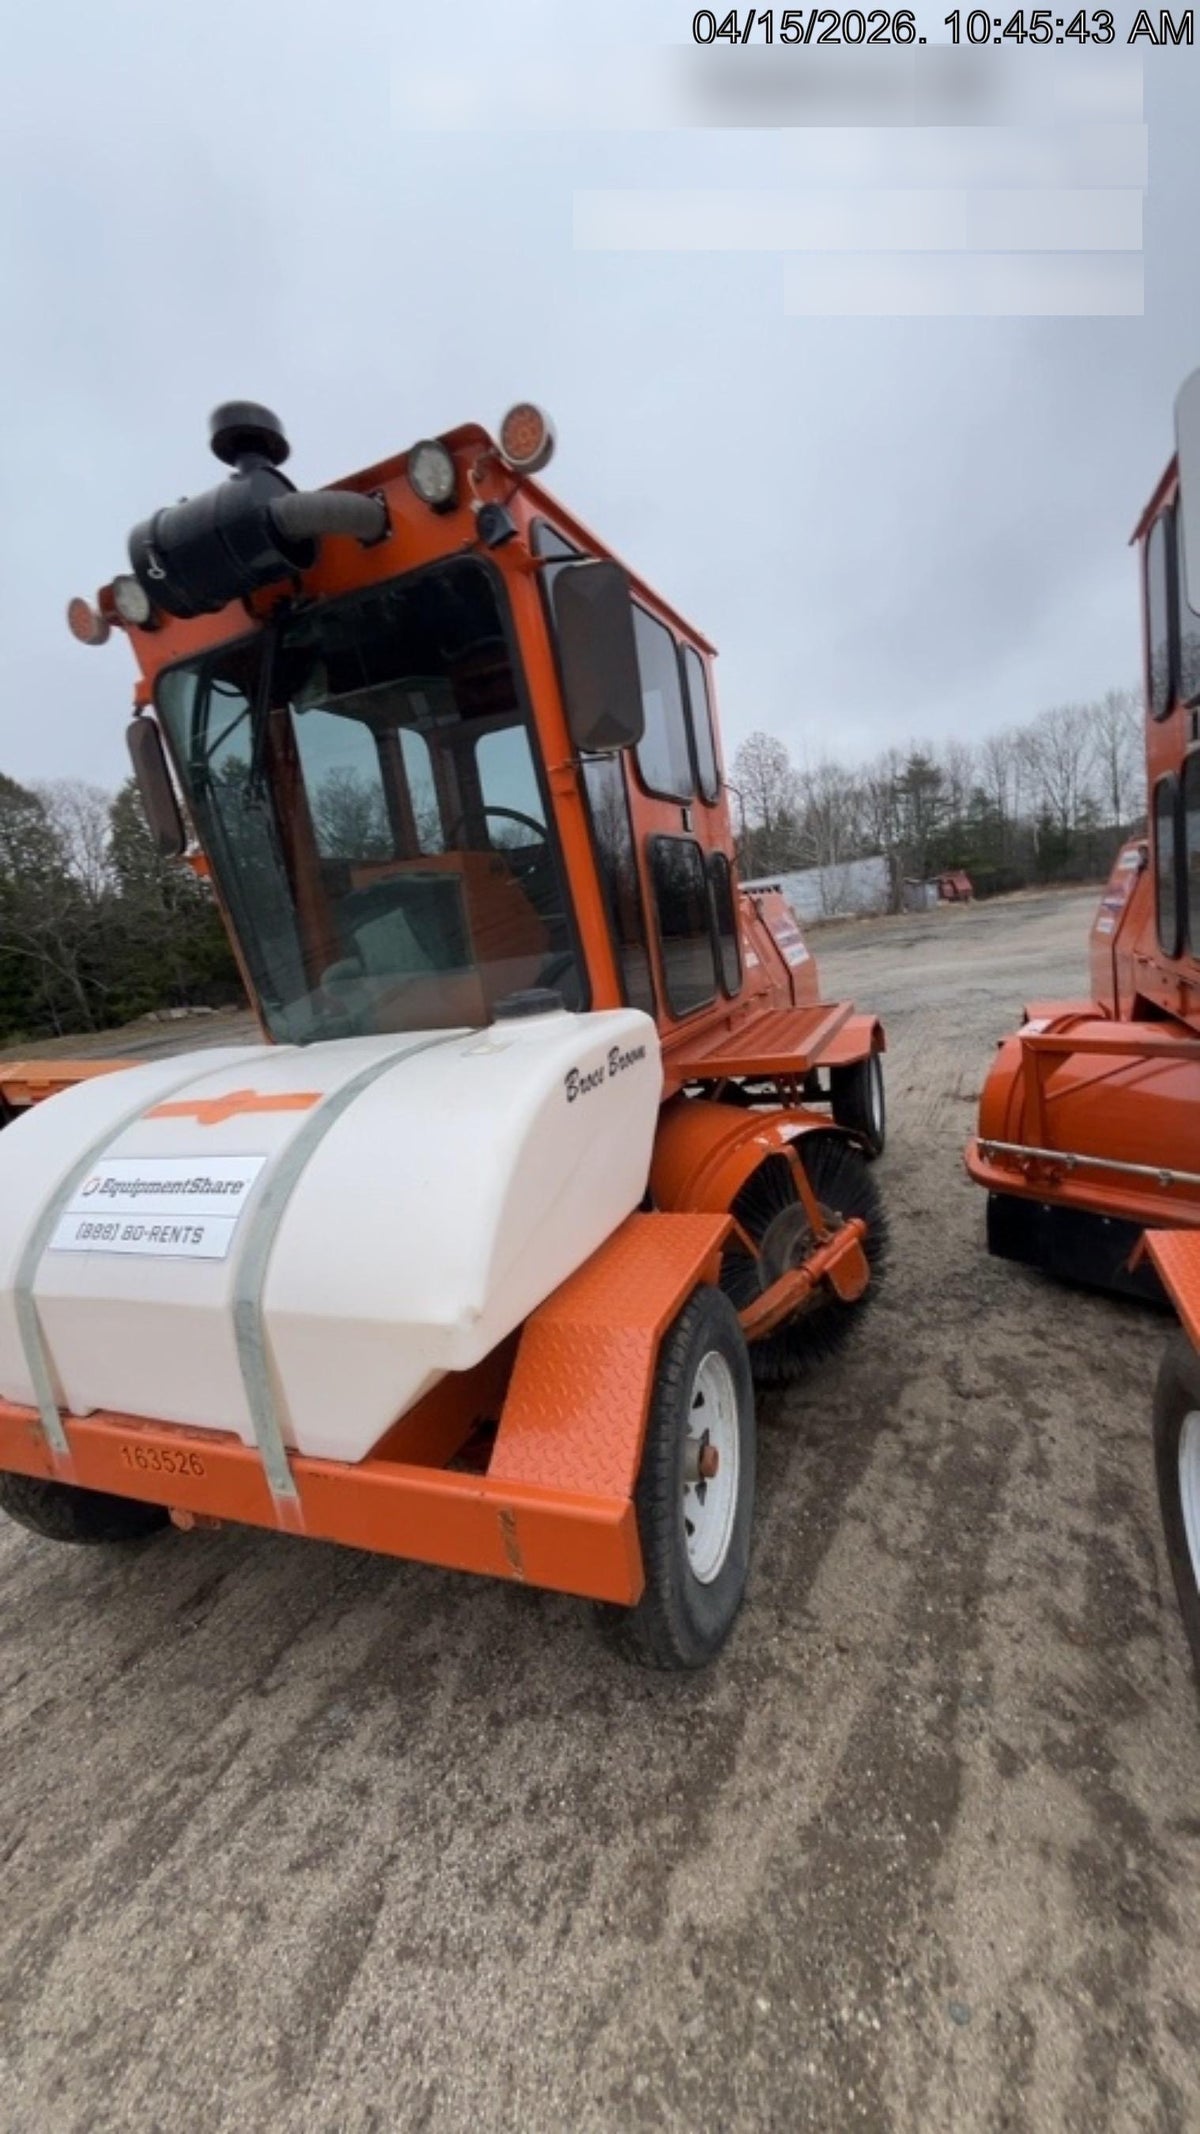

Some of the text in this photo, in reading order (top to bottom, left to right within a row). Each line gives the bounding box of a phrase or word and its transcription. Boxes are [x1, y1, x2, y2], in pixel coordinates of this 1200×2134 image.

[564, 1045, 646, 1103] Broce Broom
[98, 1177, 244, 1198] EquipmentShare
[121, 1446, 205, 1476] 163526
